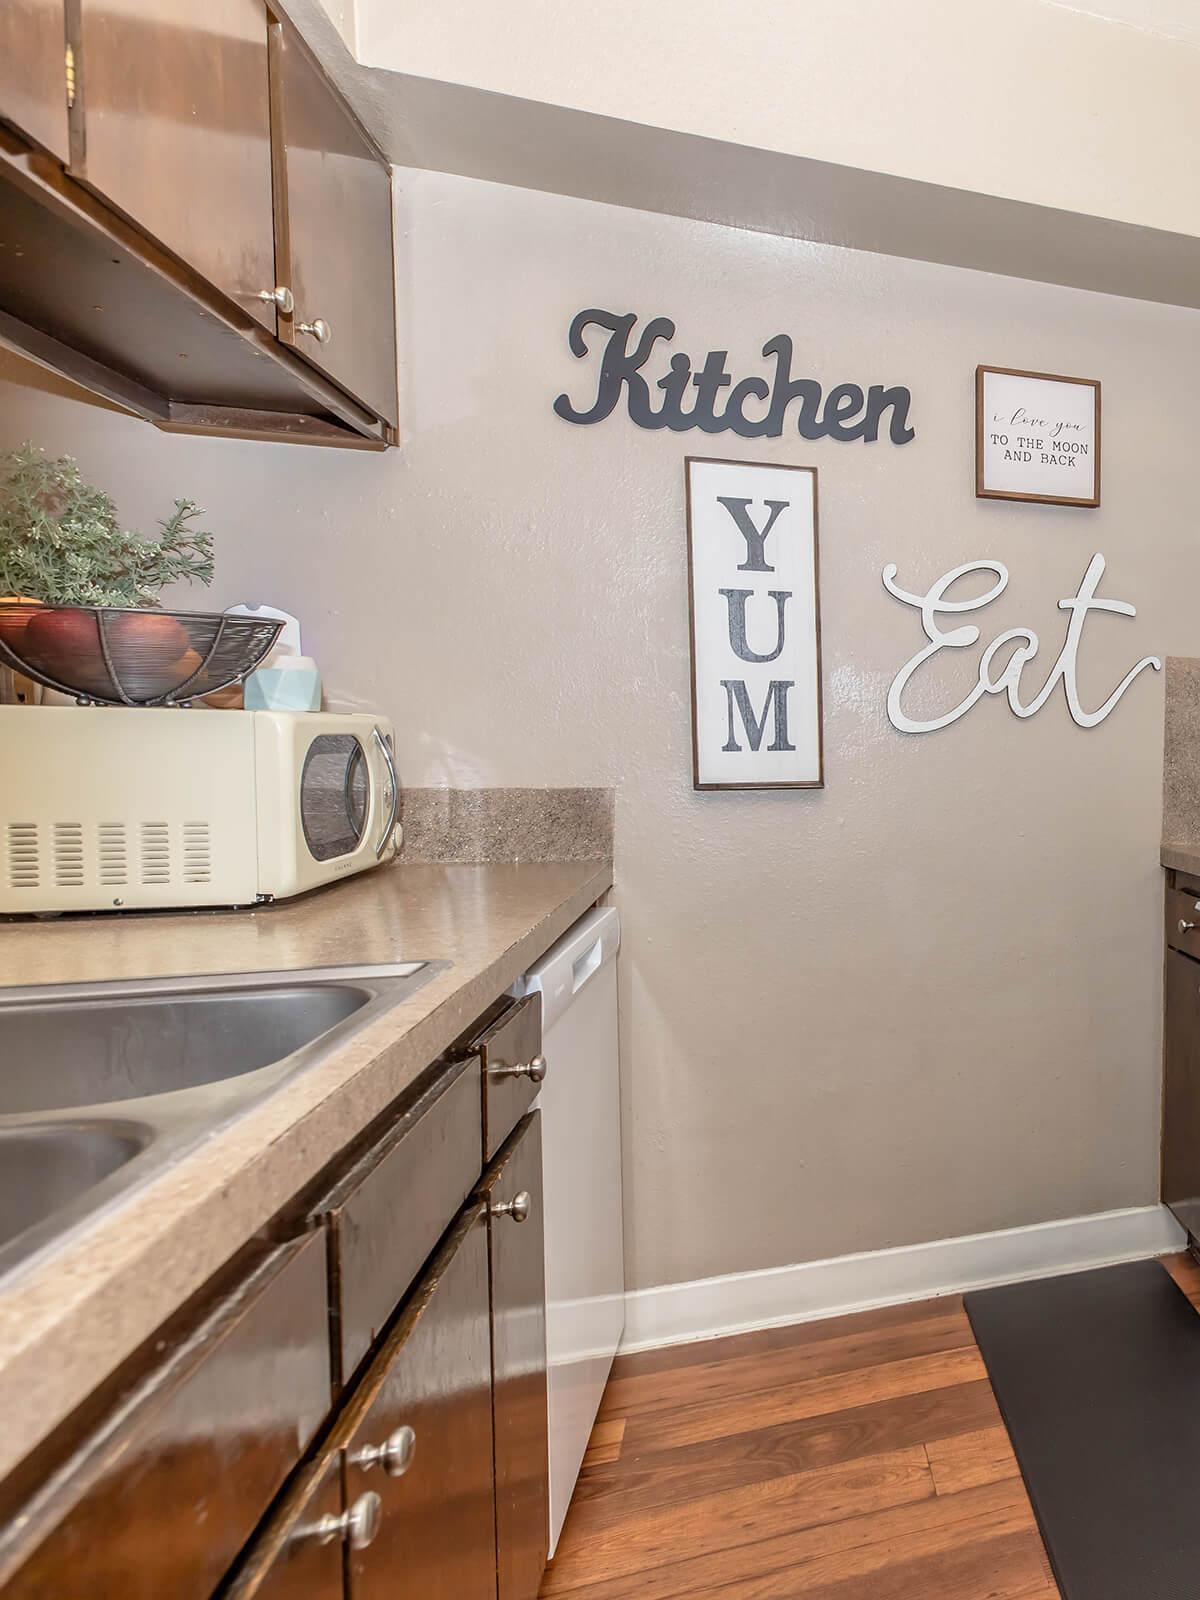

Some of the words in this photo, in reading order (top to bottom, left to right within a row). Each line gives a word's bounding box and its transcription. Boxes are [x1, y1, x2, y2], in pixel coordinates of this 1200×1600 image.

[553, 308, 915, 444] Kitchen
[991, 433, 1009, 446] TO
[1017, 437, 1044, 450] THE
[1052, 441, 1089, 455] MOON
[1003, 449, 1032, 462] AND
[1040, 453, 1076, 467] BACK
[1010, 407, 1049, 426] love
[1049, 422, 1087, 438] you
[716, 495, 797, 752] YUM
[881, 552, 1161, 734] Eat
